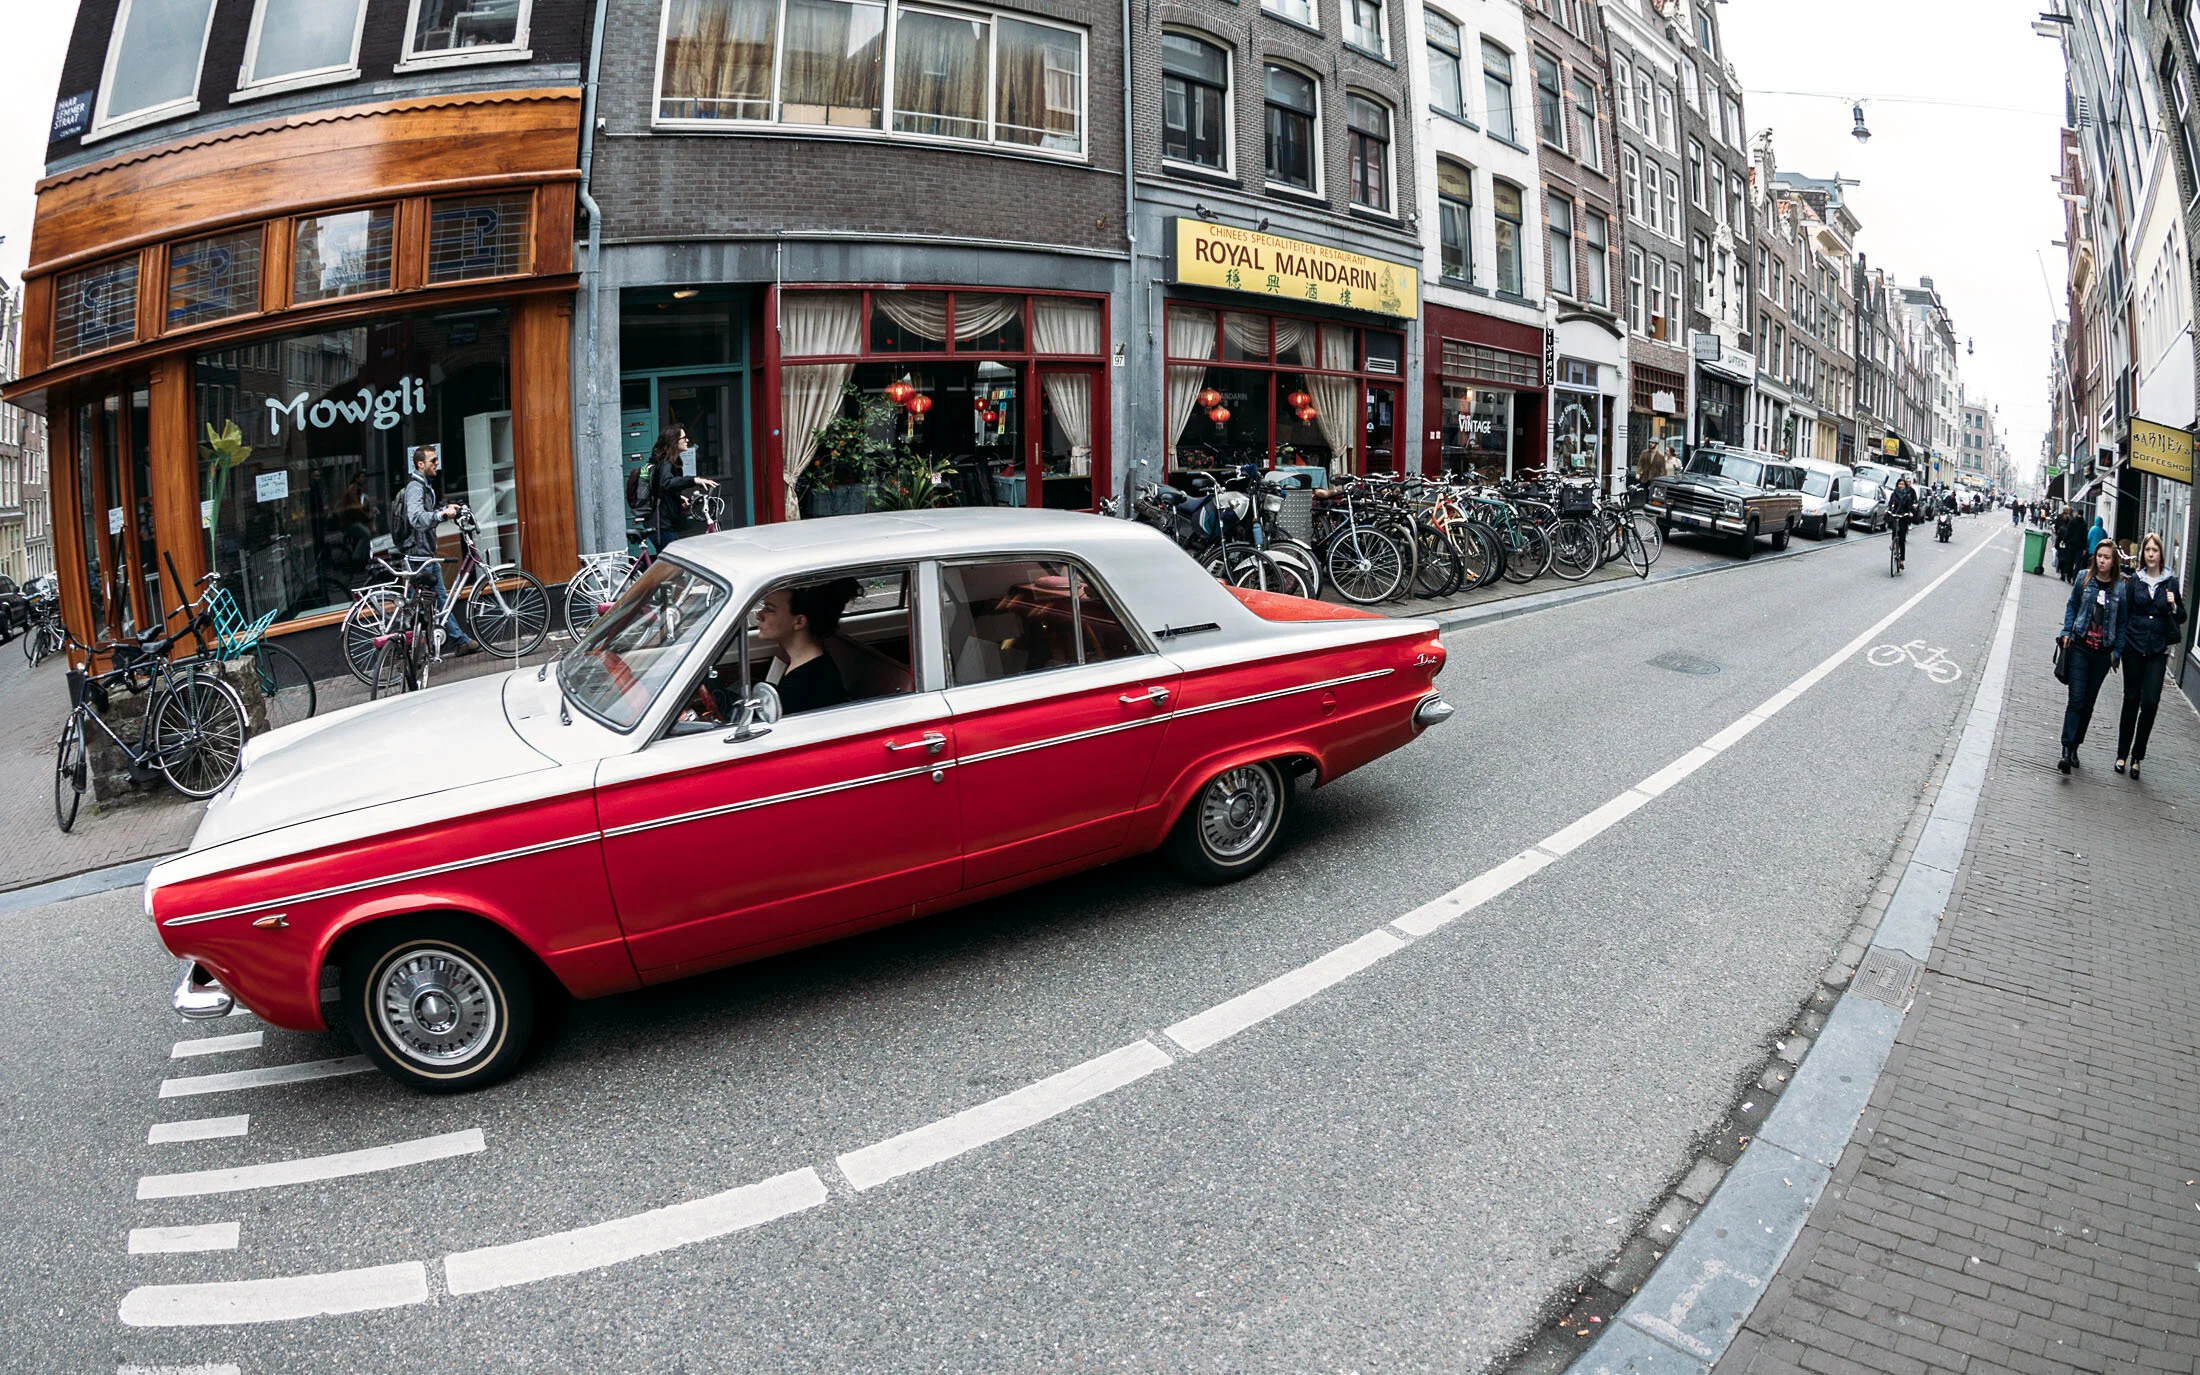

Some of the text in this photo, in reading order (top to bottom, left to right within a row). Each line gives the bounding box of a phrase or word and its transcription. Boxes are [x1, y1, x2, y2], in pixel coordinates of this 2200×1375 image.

[54, 113, 80, 130] STRAAT
[56, 102, 85, 120] LEMMER
[1209, 225, 1367, 266] CHINEES SPECIALITEITEN RESTAURANT
[1195, 237, 1377, 291] ROYAL MANDARIN
[1114, 356, 1124, 366] 97
[1546, 329, 1554, 384] VINTAGE
[265, 376, 427, 436] Mowgli
[1459, 416, 1492, 434] VINTAGE
[2132, 450, 2191, 472] COFFEESHOP
